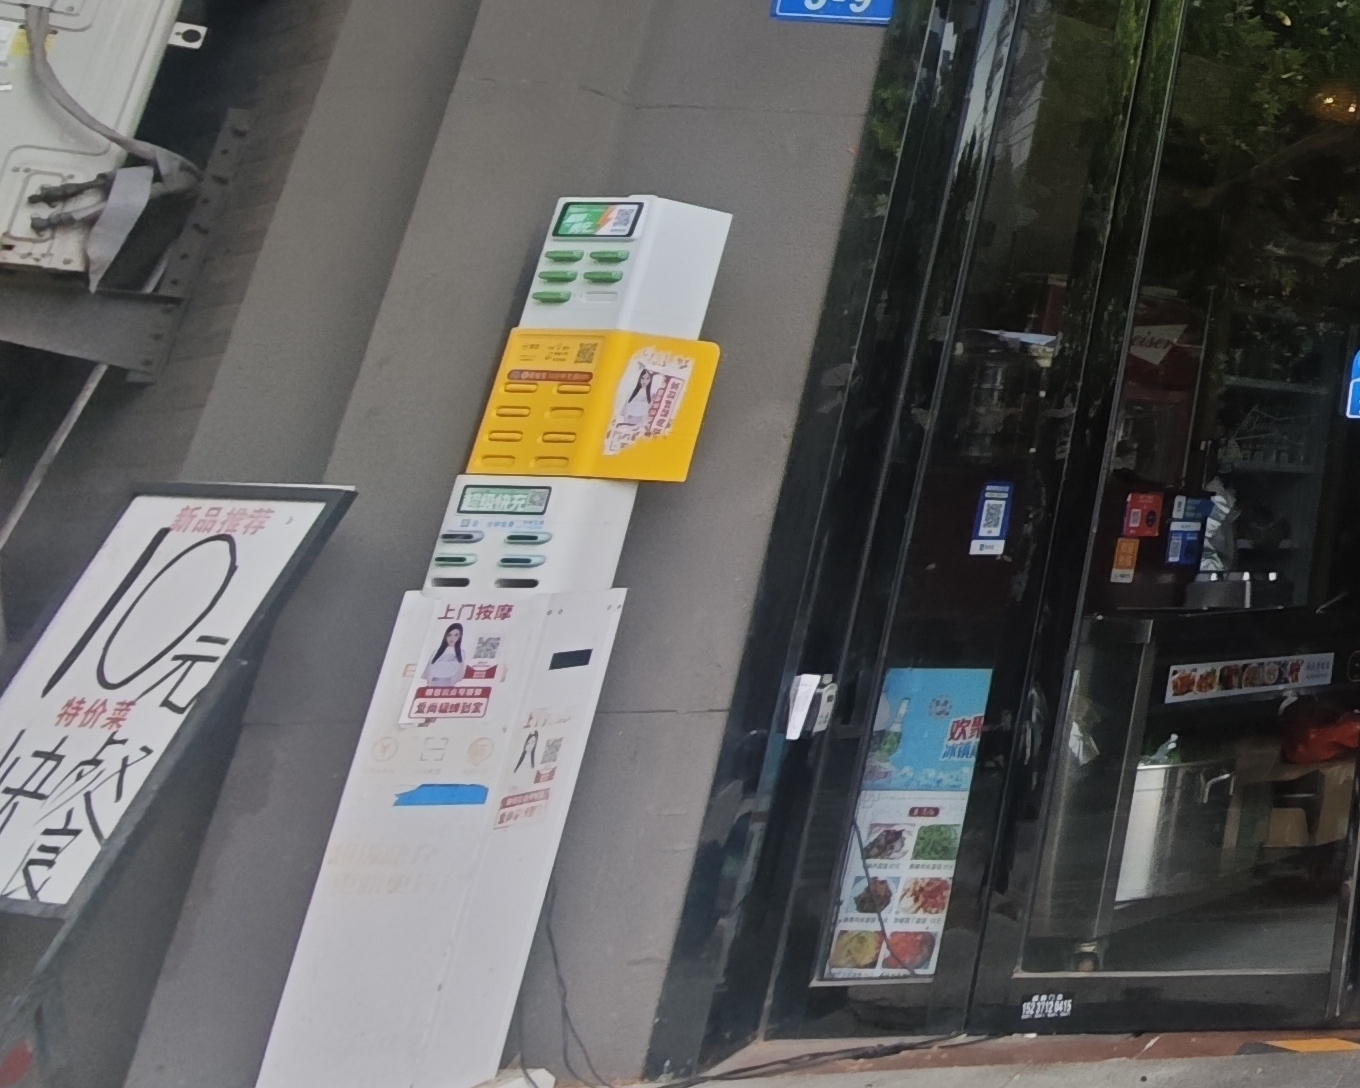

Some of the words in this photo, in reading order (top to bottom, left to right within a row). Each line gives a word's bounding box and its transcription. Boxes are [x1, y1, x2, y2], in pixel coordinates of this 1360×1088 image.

[168, 504, 276, 537] 新品推荐
[437, 603, 515, 621] 上门按摩
[56, 696, 137, 731] 特价菜
